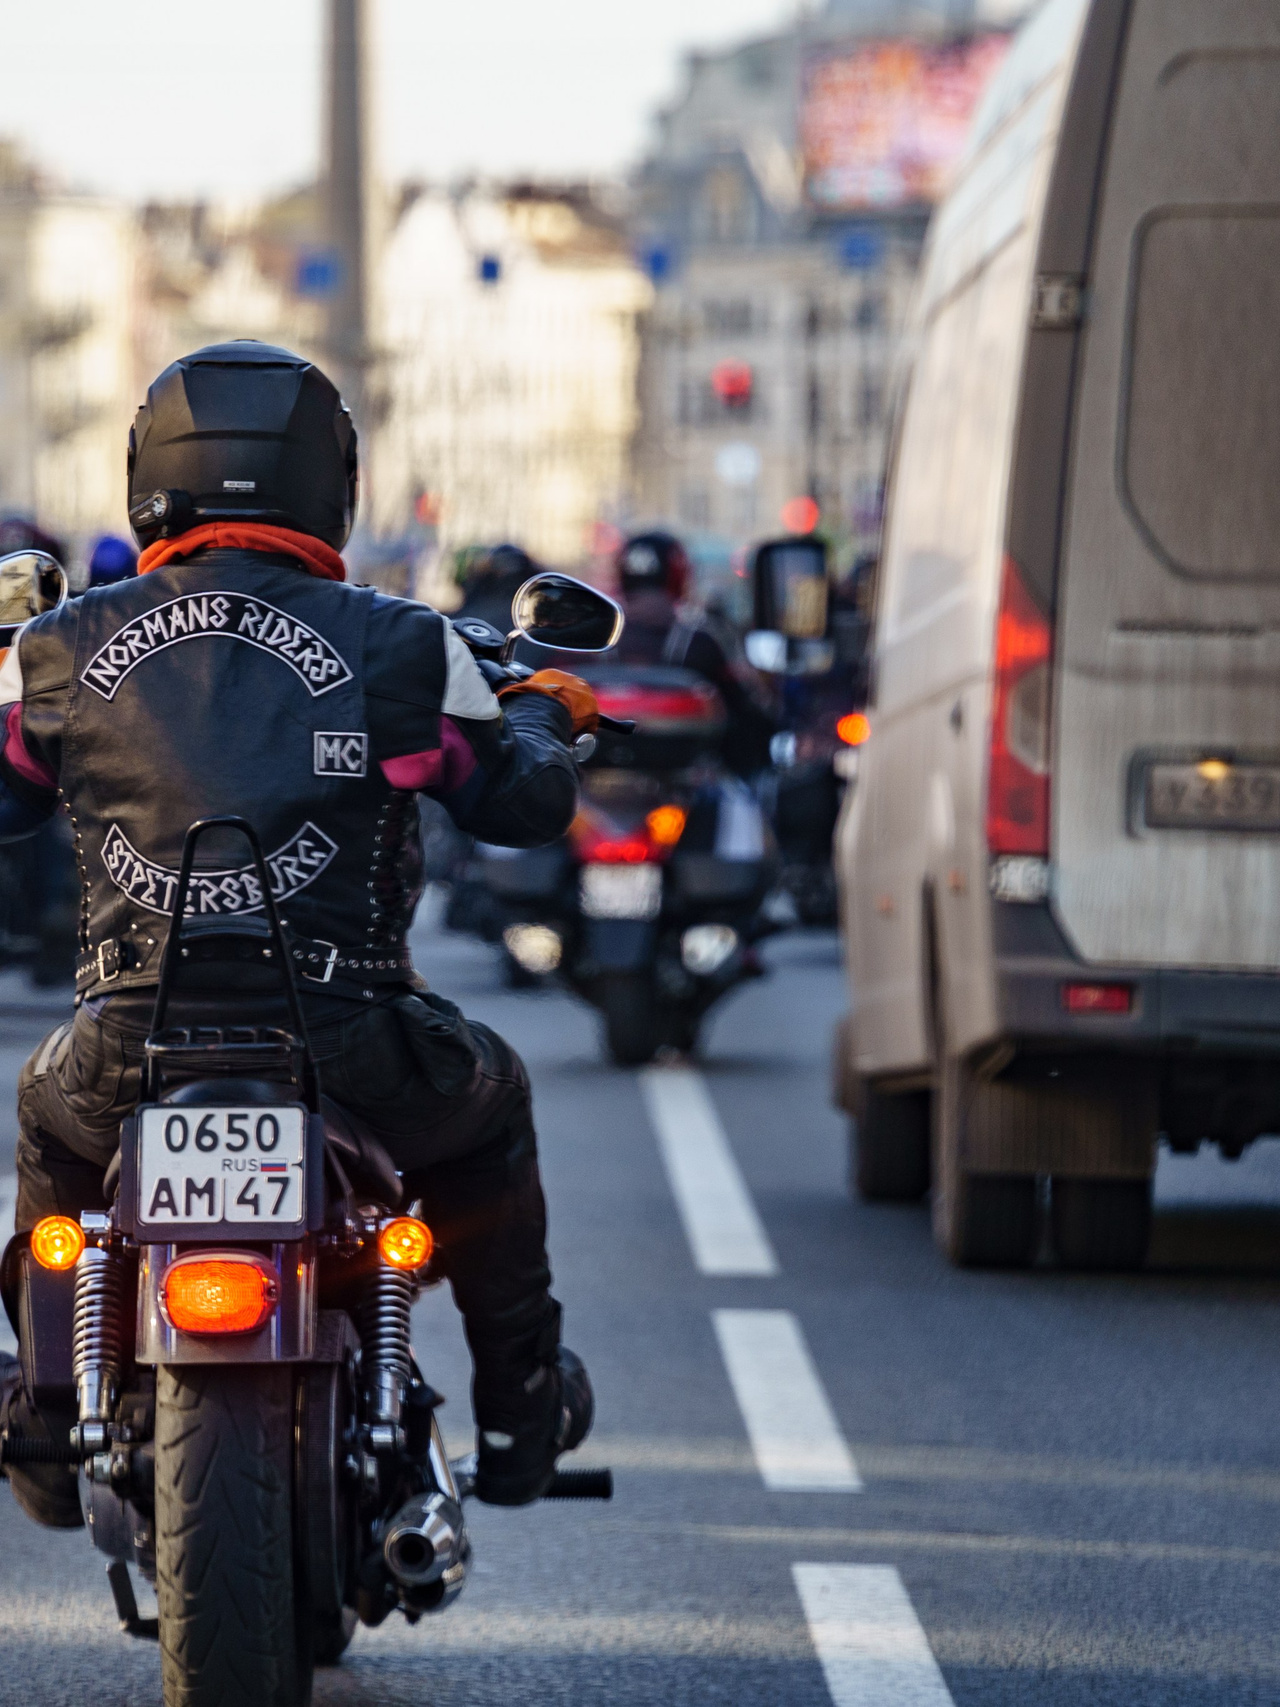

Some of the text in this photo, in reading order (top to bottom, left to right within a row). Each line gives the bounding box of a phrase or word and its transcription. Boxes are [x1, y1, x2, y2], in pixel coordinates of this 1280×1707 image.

[88, 596, 339, 688] NORMANS RIDERS
[318, 736, 363, 772] MC
[164, 1113, 280, 1152] 0650
[221, 1158, 259, 1172] RUS
[148, 1176, 291, 1217] AM 47
